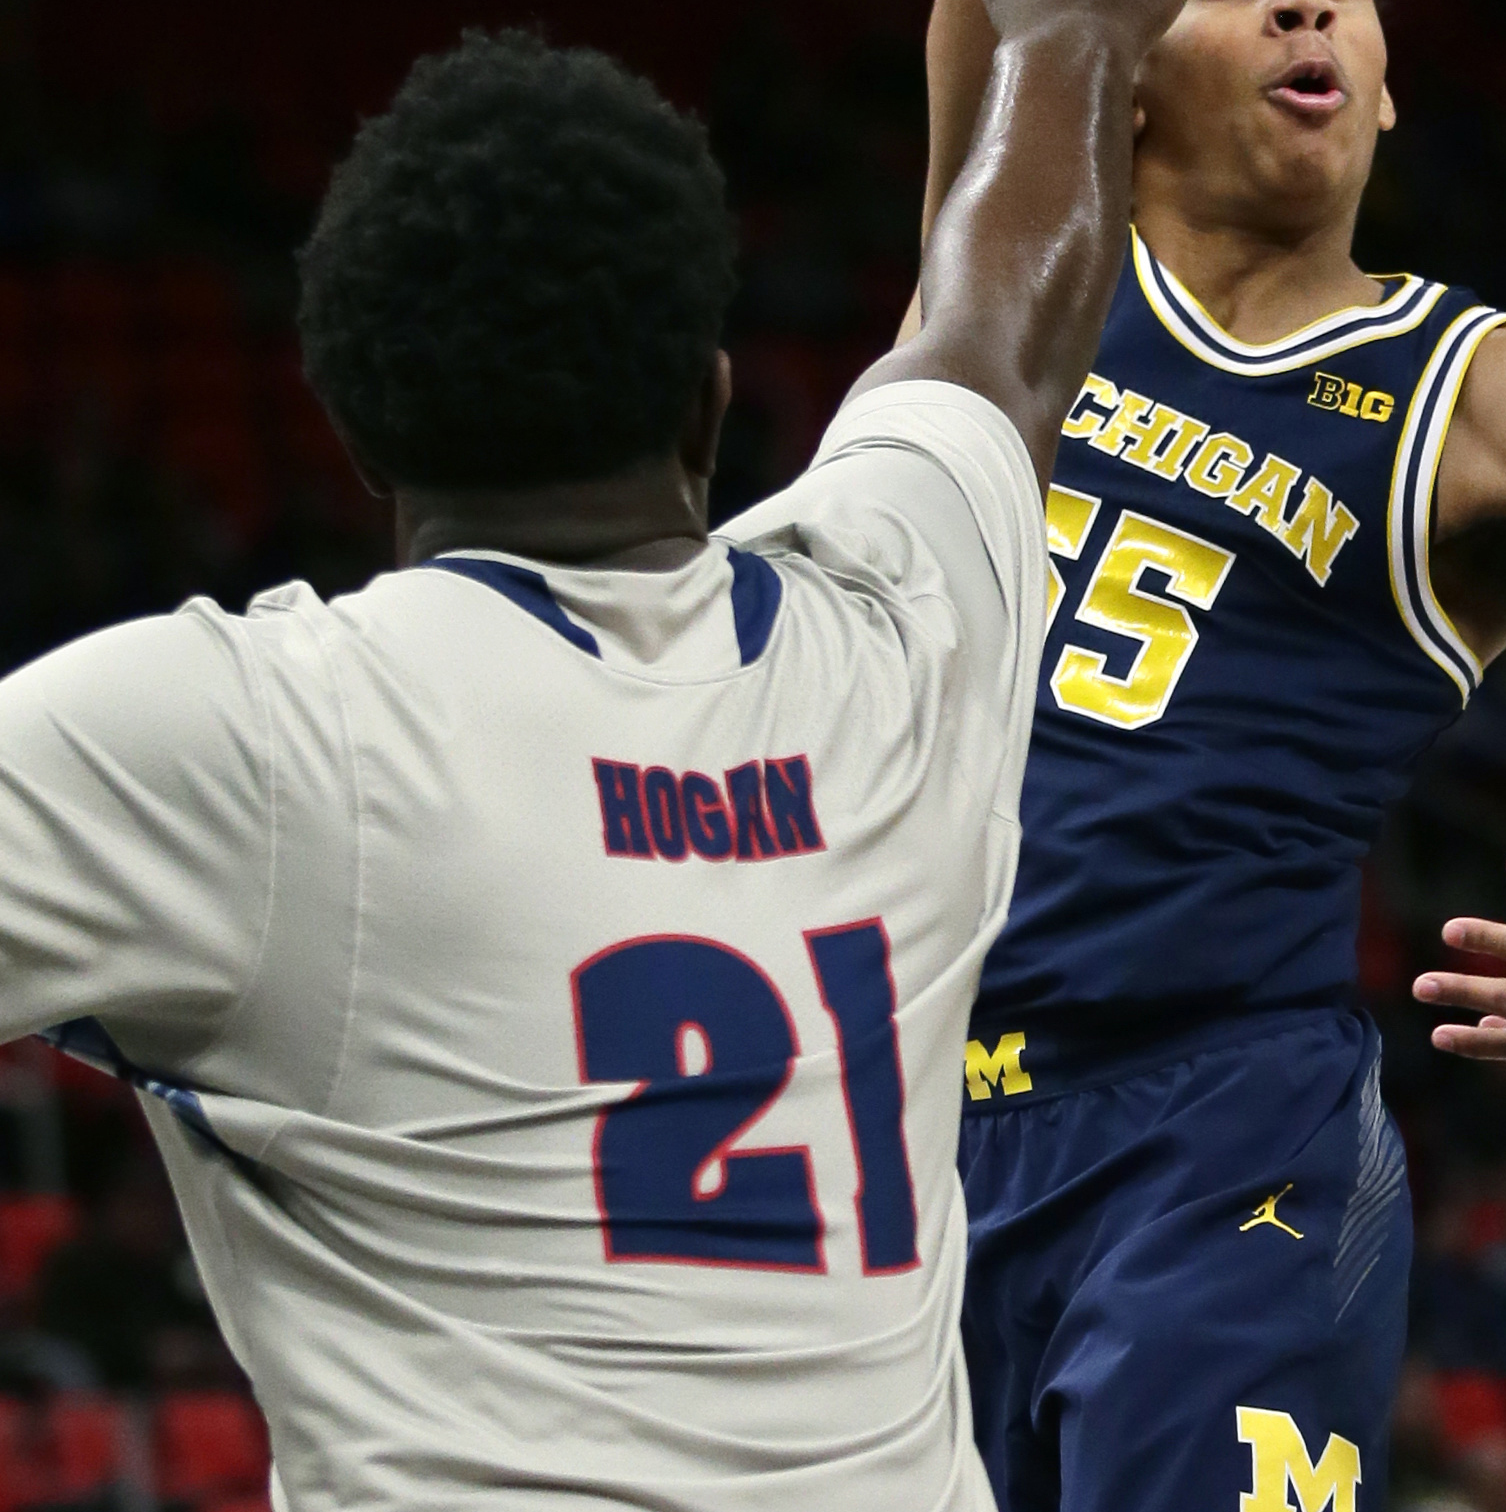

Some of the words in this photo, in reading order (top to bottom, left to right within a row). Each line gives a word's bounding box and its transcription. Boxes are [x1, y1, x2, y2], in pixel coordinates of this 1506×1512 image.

[1061, 372, 1360, 587] CHIGAN
[591, 753, 827, 863] HOGAN
[570, 915, 923, 1278] 21
[964, 1031, 1033, 1101] M
